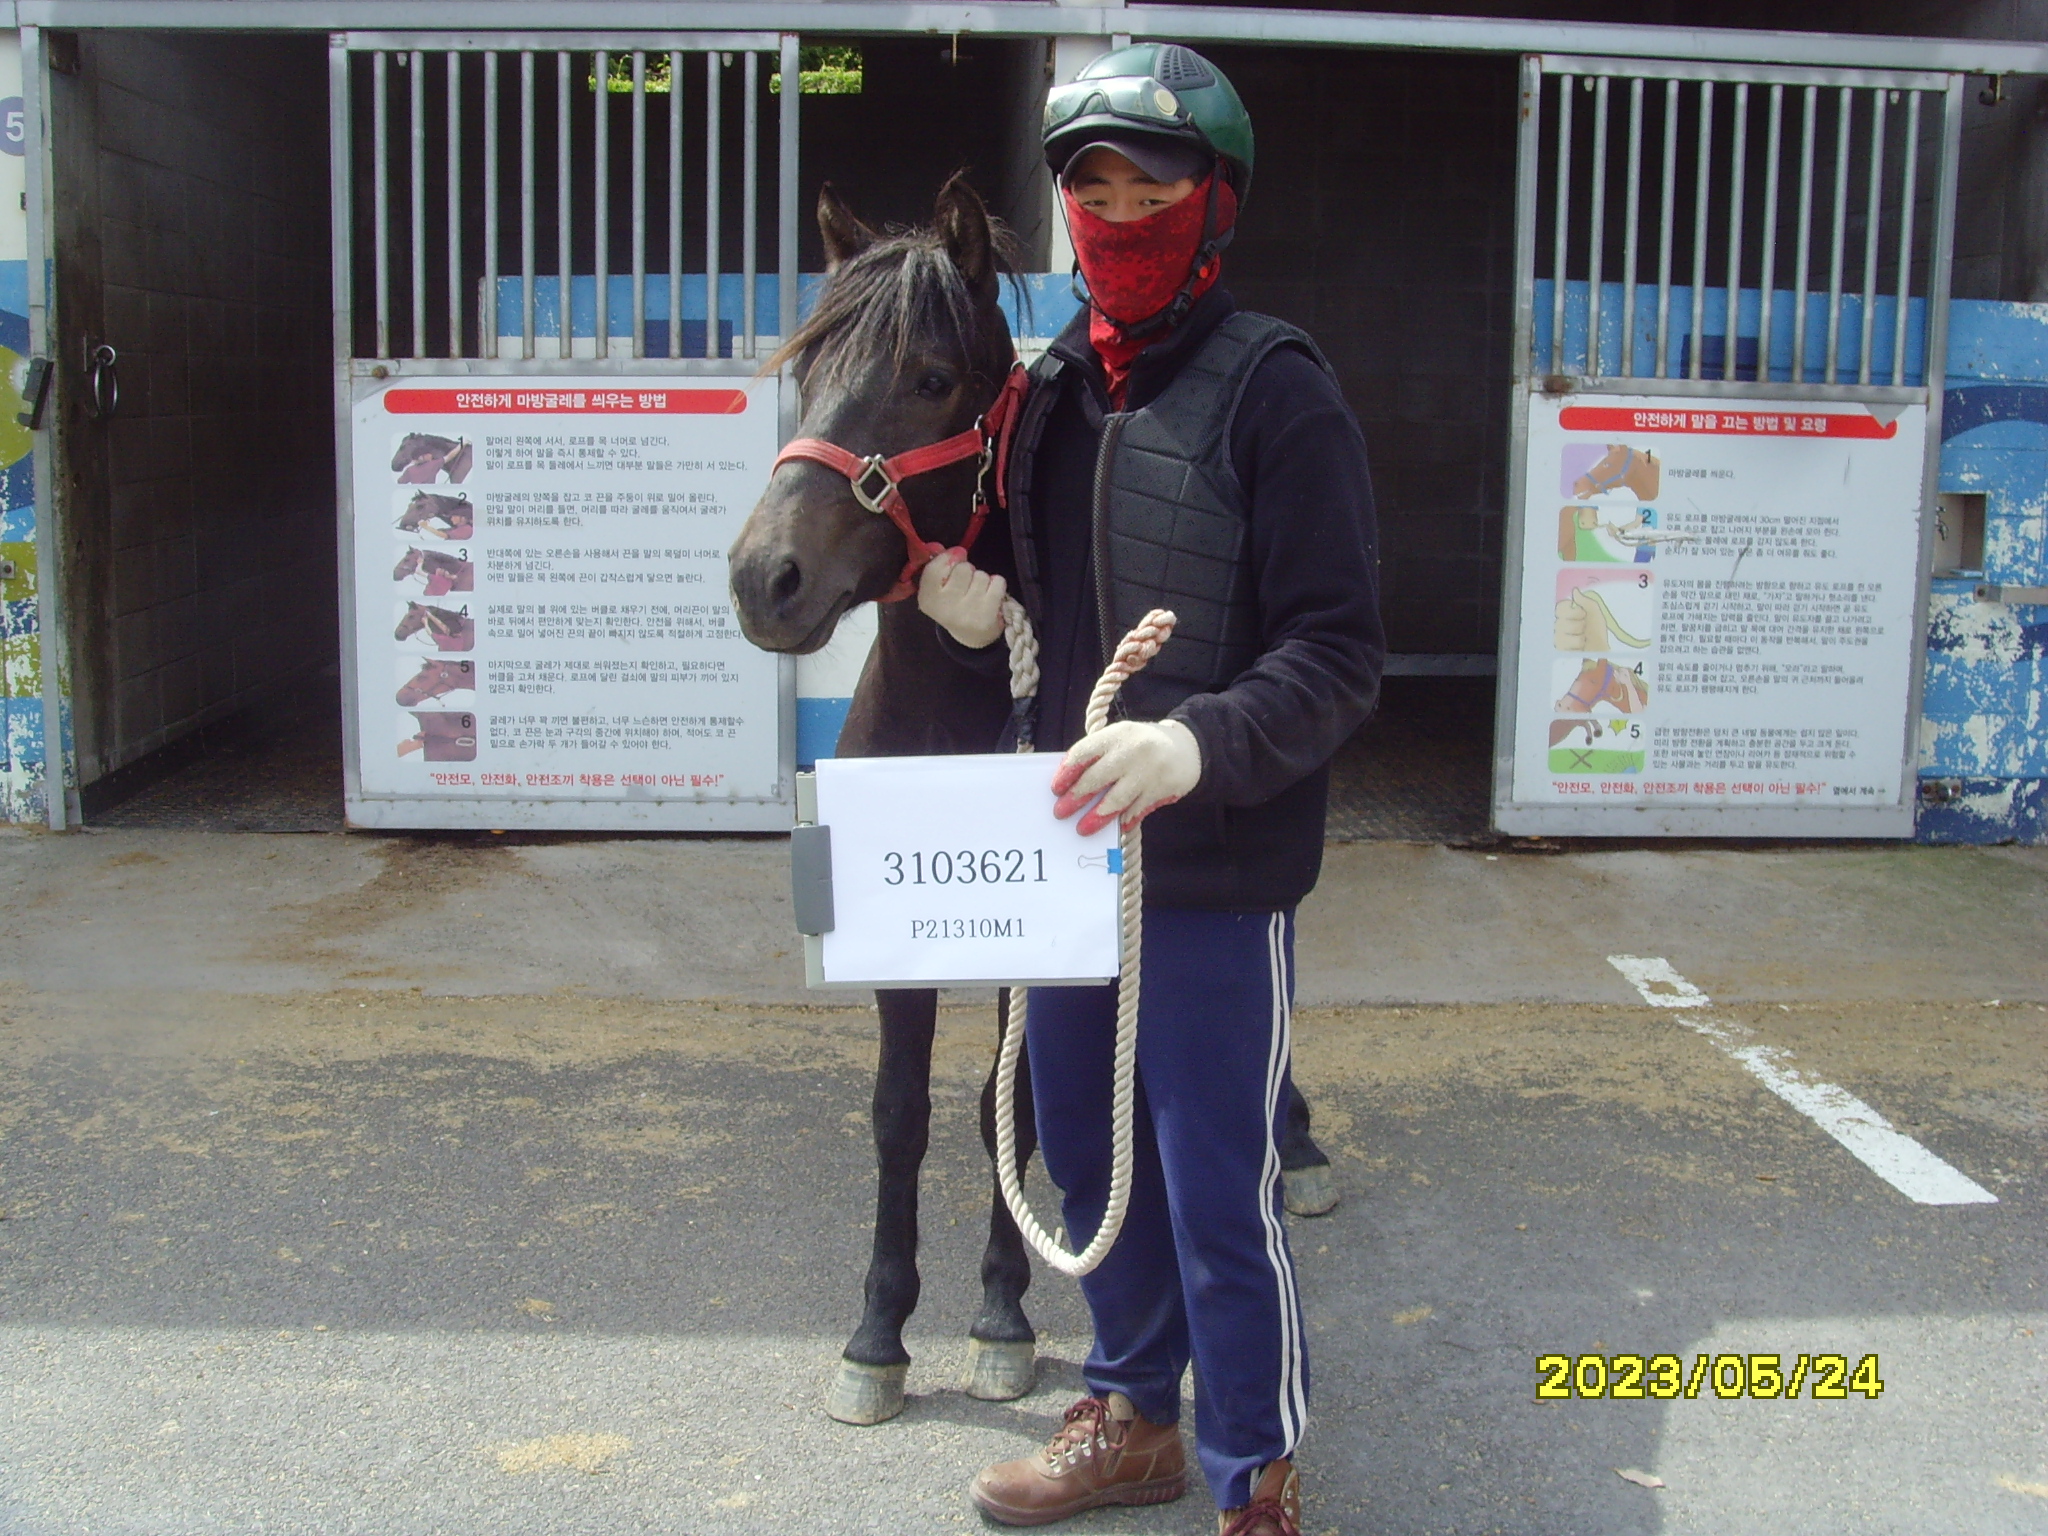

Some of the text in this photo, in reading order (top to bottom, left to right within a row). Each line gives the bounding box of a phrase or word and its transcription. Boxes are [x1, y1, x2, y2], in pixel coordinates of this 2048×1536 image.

[6, 112, 24, 142] 5
[455, 393, 666, 408] 안전하게 마방굴레를 씌우는 방법
[1633, 412, 1826, 432] 안전하게 말을 끄는 방법 및 요령
[458, 436, 464, 449] 1
[485, 435, 512, 445] 말머리
[515, 435, 542, 445] 왼쪽에
[568, 436, 595, 445] 로프를
[597, 436, 607, 445] 목
[610, 436, 637, 446] 너머로
[485, 447, 512, 457] 이렇게
[515, 447, 533, 457] 하여
[536, 448, 553, 457] 말을
[557, 448, 575, 458] 즉시
[578, 448, 604, 458] 통제할
[607, 448, 616, 458] 수
[1645, 449, 1651, 464] 1
[485, 460, 503, 469] 말이
[506, 460, 533, 469] 로프를
[536, 460, 545, 469] 목
[586, 460, 613, 470] 느끼면
[616, 460, 643, 470] 대부분
[646, 460, 673, 470] 말들은
[676, 460, 703, 470] 가만히
[706, 461, 715, 470] 서
[458, 492, 467, 506] 2
[486, 492, 530, 502] 마방굴레의
[532, 492, 559, 502] 양쪽을
[562, 492, 580, 502] 잡고
[583, 492, 593, 502] 코
[595, 492, 613, 502] 끈을
[616, 492, 643, 502] 주둥이
[646, 492, 664, 502] 위로
[667, 493, 685, 502] 밀어
[486, 504, 504, 514] 만일
[506, 504, 524, 514] 말이
[527, 504, 554, 514] 머리를
[580, 504, 607, 514] 머리를
[610, 505, 628, 514] 따라
[631, 505, 658, 514] 굴레를
[661, 505, 696, 515] 움직여서
[699, 505, 727, 515] 굴레가
[486, 516, 512, 526] 위치를
[516, 516, 559, 526] 유지하도록
[1642, 509, 1652, 524] 2
[458, 548, 468, 562] 3
[486, 548, 720, 558] 반대쪽에 있는 오른손을 사용해서 끈을 말의 목덜미 너머로
[486, 560, 522, 570] 차분하게
[486, 572, 504, 582] 어떤
[507, 572, 534, 582] 말들은
[536, 572, 546, 582] 목
[549, 572, 575, 582] 왼쪽에
[578, 572, 596, 582] 끈이
[599, 573, 643, 582] 갑작스럽게
[1638, 574, 1648, 589] 3
[459, 604, 469, 618] 4
[460, 660, 470, 673] 5
[488, 660, 531, 670] 마지막으로
[535, 660, 561, 670] 굴레가
[563, 660, 590, 670] 제대로
[681, 660, 725, 670] 필요하다면
[1633, 661, 1643, 676] 4
[488, 672, 515, 681] 버클을
[517, 672, 535, 681] 고쳐
[569, 672, 596, 681] 로프에
[599, 672, 617, 681] 달린
[649, 672, 668, 682] 말의
[670, 672, 697, 682] 피부가
[699, 673, 717, 682] 끼어
[720, 673, 739, 682] 있지
[488, 684, 515, 694] 않은지
[461, 715, 471, 729] 6
[489, 715, 515, 725] 굴레가
[518, 715, 536, 725] 너무
[550, 716, 568, 725] 끼면
[612, 716, 629, 725] 너무
[632, 716, 668, 725] 느슨하면
[670, 716, 706, 726] 안전하게
[512, 727, 521, 736] 코
[524, 727, 542, 736] 끈은
[545, 727, 562, 737] 눈과
[594, 727, 621, 737] 중간에
[624, 728, 659, 737] 위치해야
[686, 728, 712, 737] 적어도
[715, 728, 724, 737] 코
[727, 728, 736, 737] 끈
[1630, 724, 1640, 739] 5
[525, 773, 574, 786] 안전조끼
[579, 774, 615, 786] 착용은
[620, 774, 656, 786] 선택이
[660, 774, 684, 786] 아닌
[1642, 782, 1688, 794] 안전조끼
[1692, 782, 1726, 794] 착용은
[1730, 782, 1764, 794] 선택이
[1768, 783, 1790, 795] 아닌
[883, 848, 1048, 885] 3103621
[911, 918, 1025, 939] P21310M1
